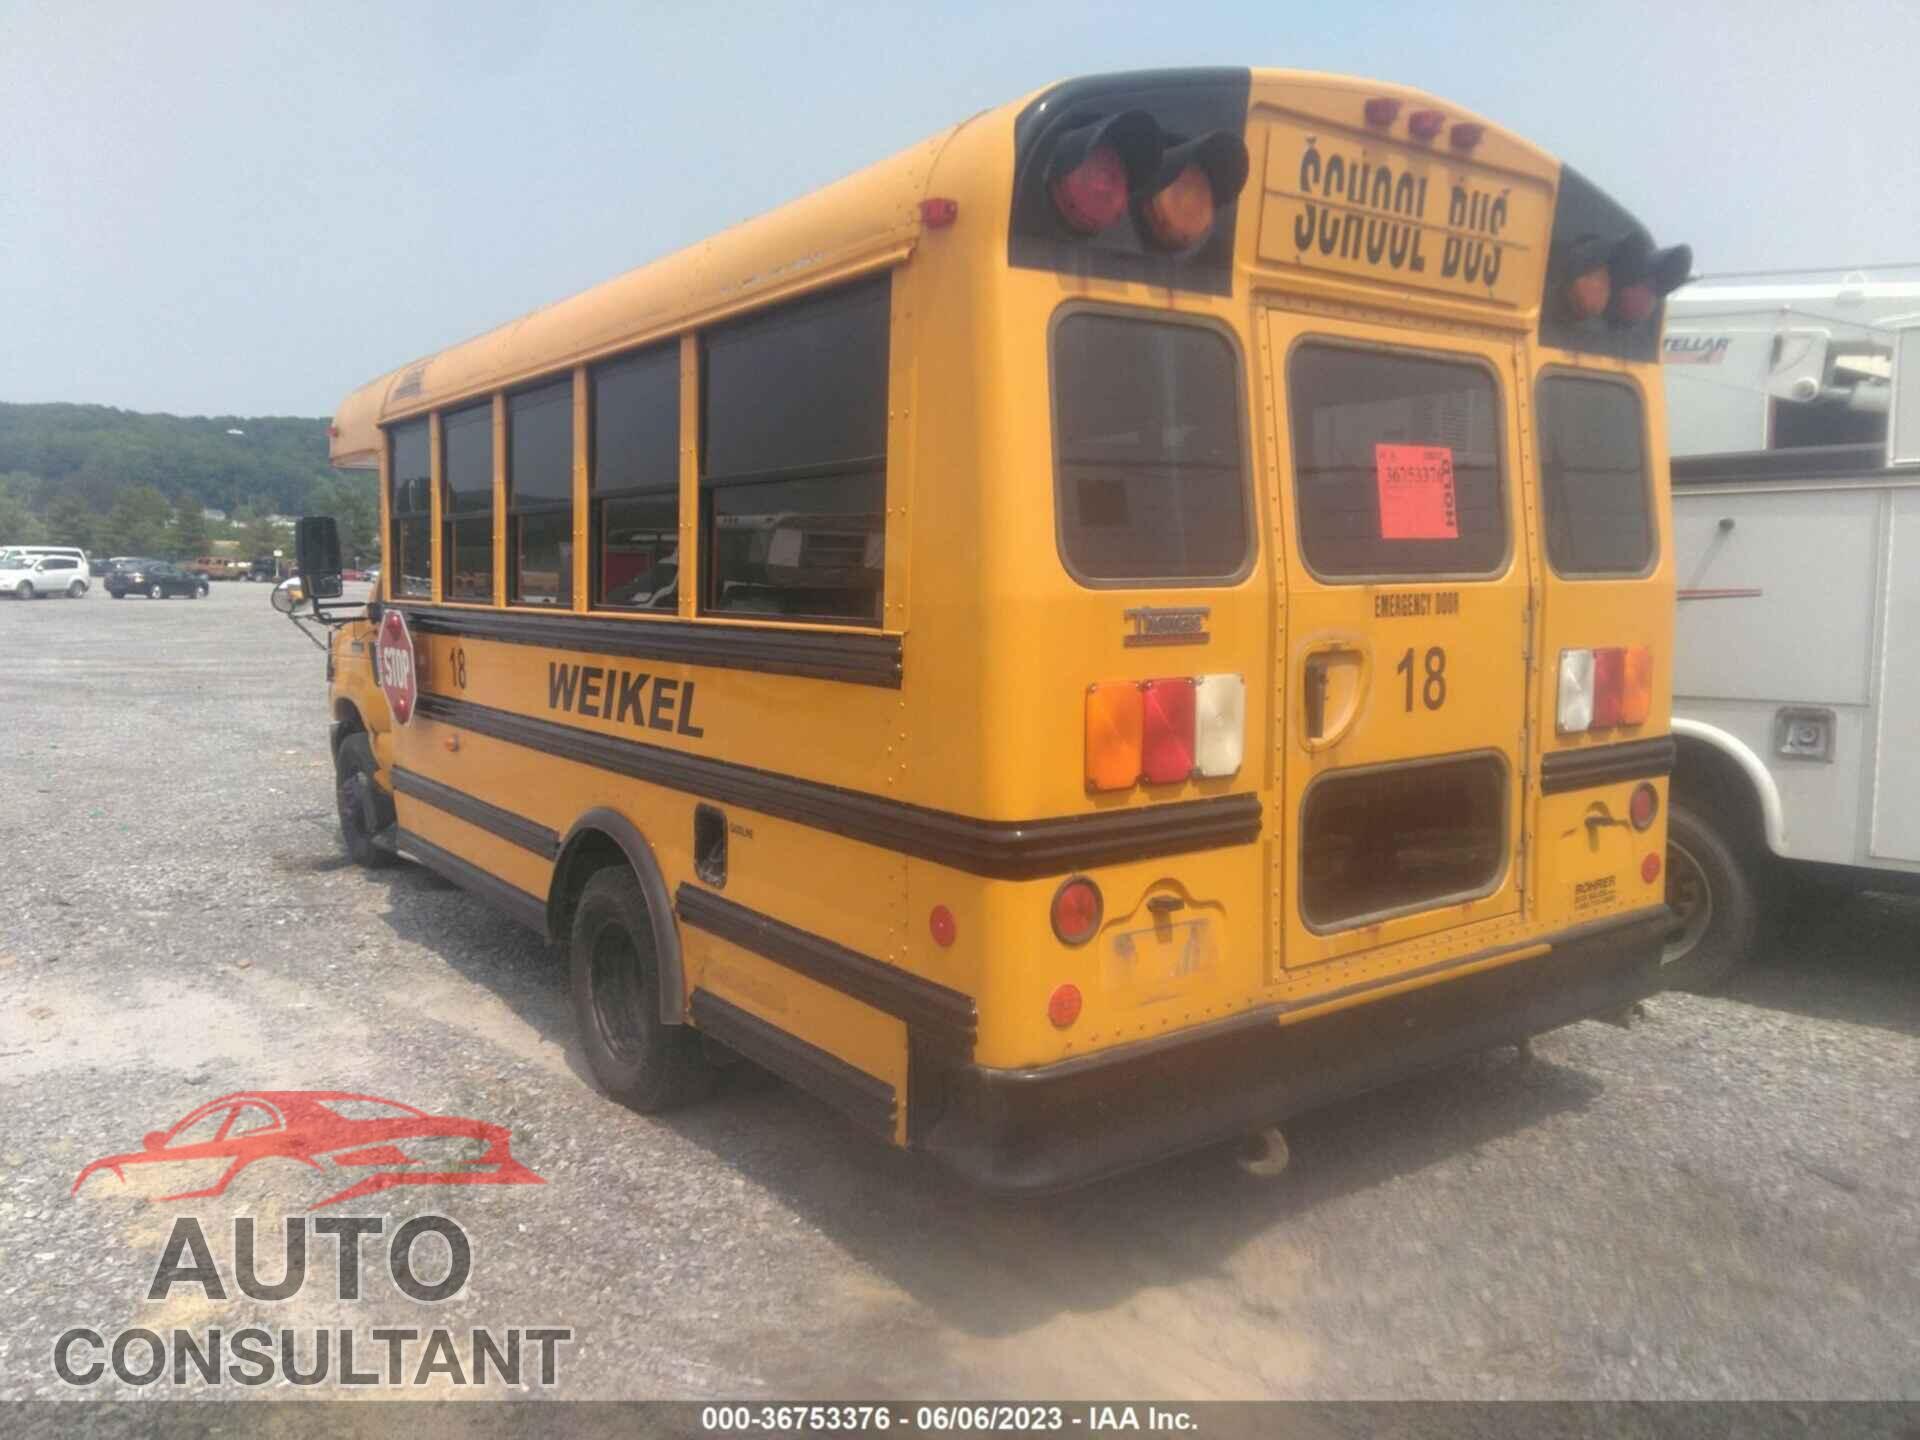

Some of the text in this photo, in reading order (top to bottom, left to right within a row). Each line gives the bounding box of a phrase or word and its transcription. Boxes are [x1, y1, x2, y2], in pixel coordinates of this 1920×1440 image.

[1295, 144, 1511, 287] SCHOOL BUS
[1664, 336, 1729, 352] TELLAR
[1374, 594, 1431, 618] EMERGENCY
[384, 647, 410, 689] STOP
[450, 647, 466, 689] 18
[1397, 646, 1447, 712] 18
[548, 661, 704, 739] WEIKEL
